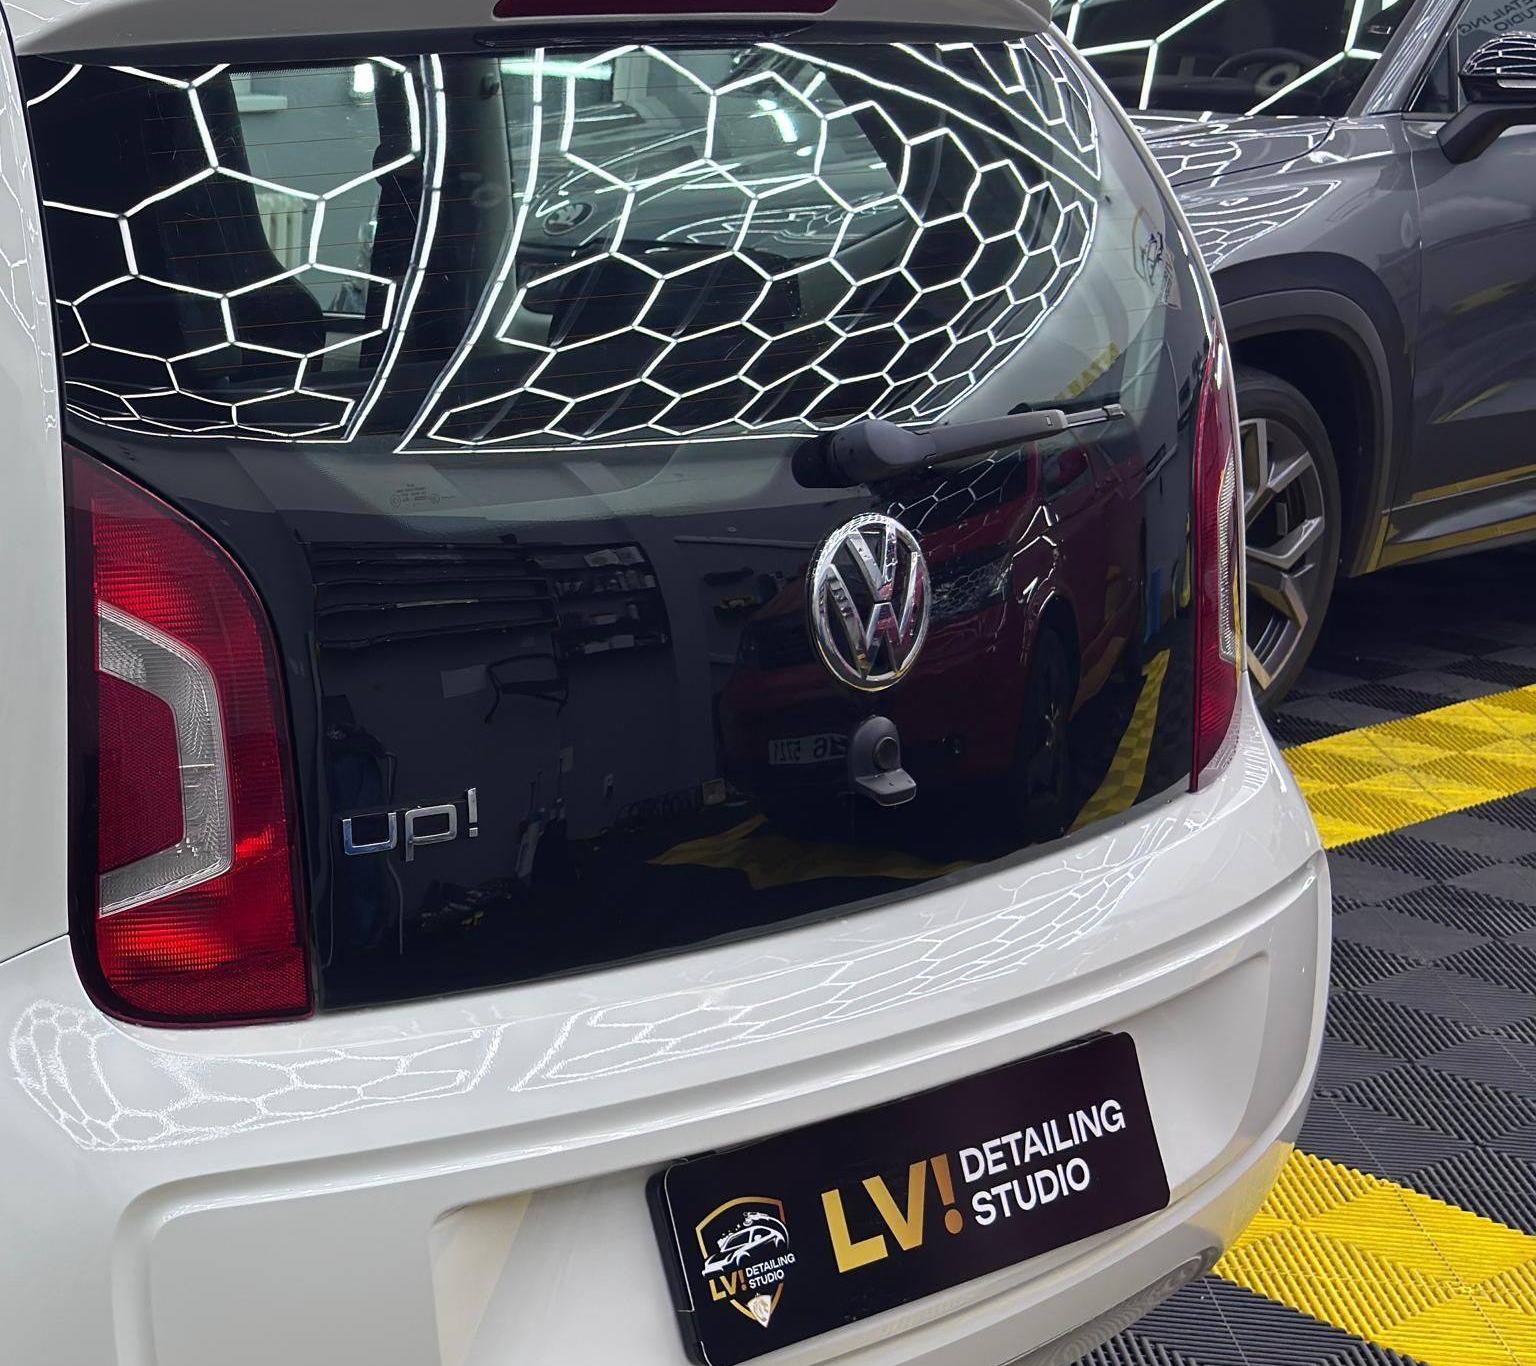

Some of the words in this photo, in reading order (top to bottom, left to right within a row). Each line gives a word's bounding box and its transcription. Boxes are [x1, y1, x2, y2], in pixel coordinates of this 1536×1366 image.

[342, 787, 479, 863] up!
[958, 1098, 1126, 1183] DETAILING
[820, 1152, 965, 1273] LV!
[970, 1156, 1091, 1226] STUDIO
[708, 1269, 748, 1302] LV!
[745, 1251, 796, 1278] DETAILING
[748, 1269, 785, 1290] STUDIO
